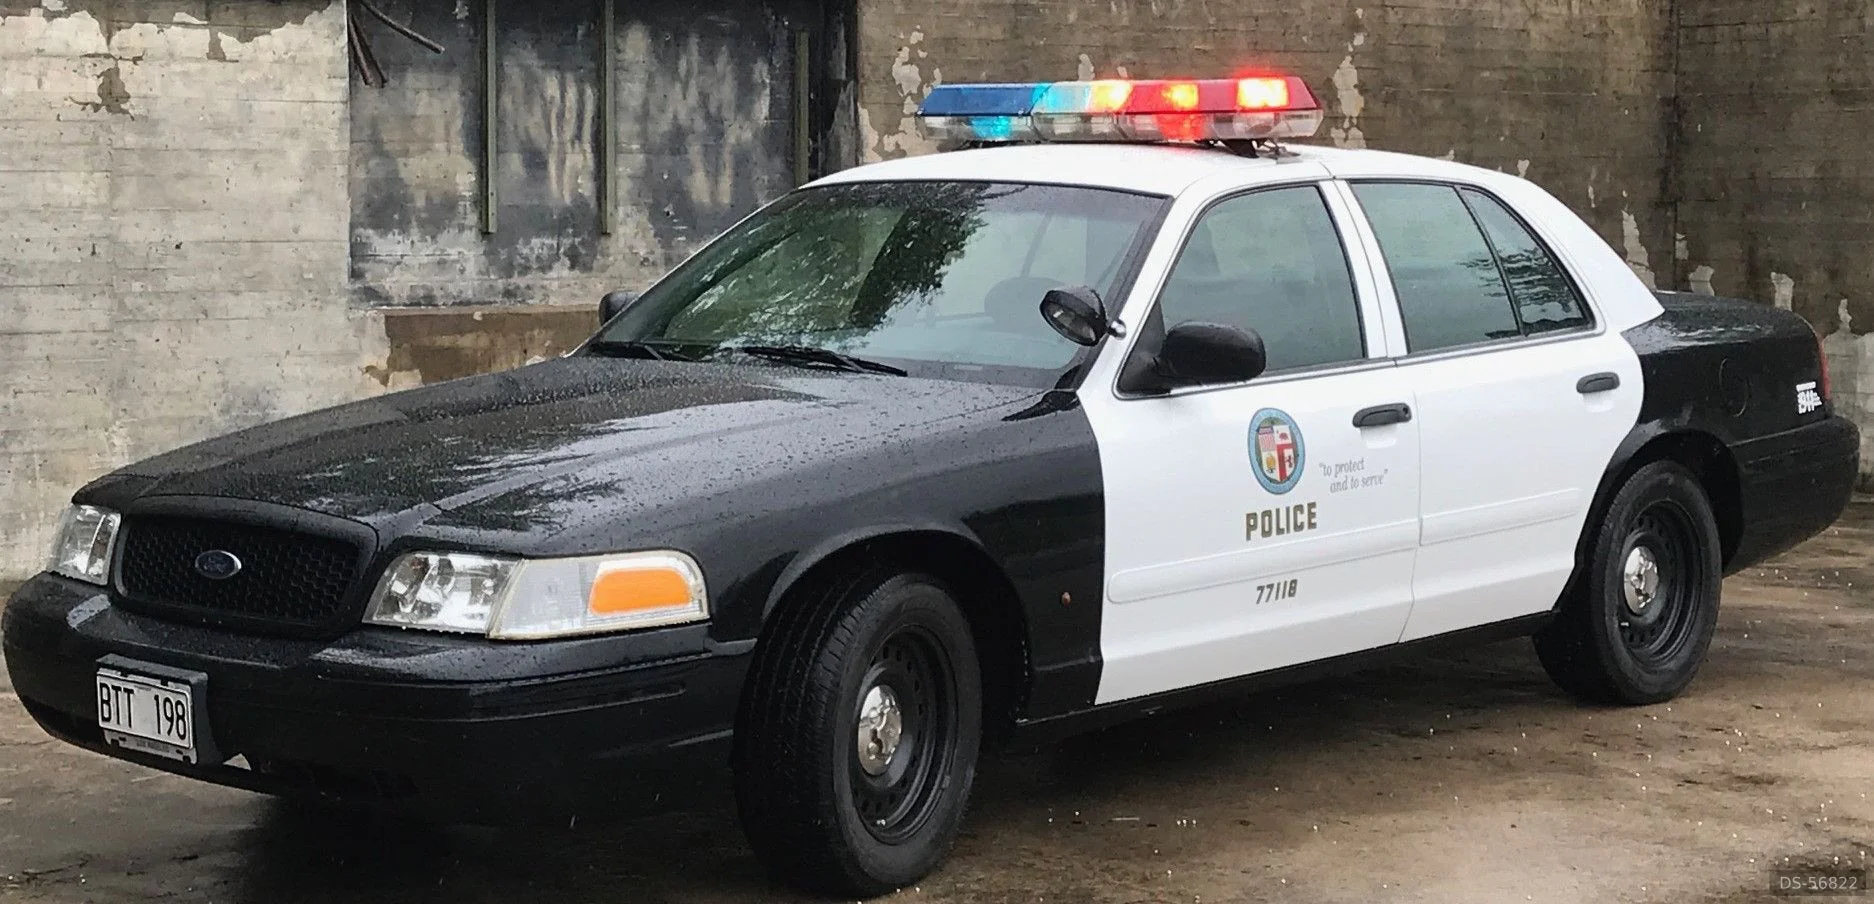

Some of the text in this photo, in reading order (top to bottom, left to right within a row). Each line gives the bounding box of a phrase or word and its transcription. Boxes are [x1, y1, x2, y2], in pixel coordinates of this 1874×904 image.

[1334, 458, 1365, 478] protect
[1330, 475, 1348, 494] and
[1350, 476, 1360, 490] to
[1246, 501, 1318, 541] POLICE
[1256, 578, 1299, 605] 77118
[100, 681, 187, 740] BTT 198
